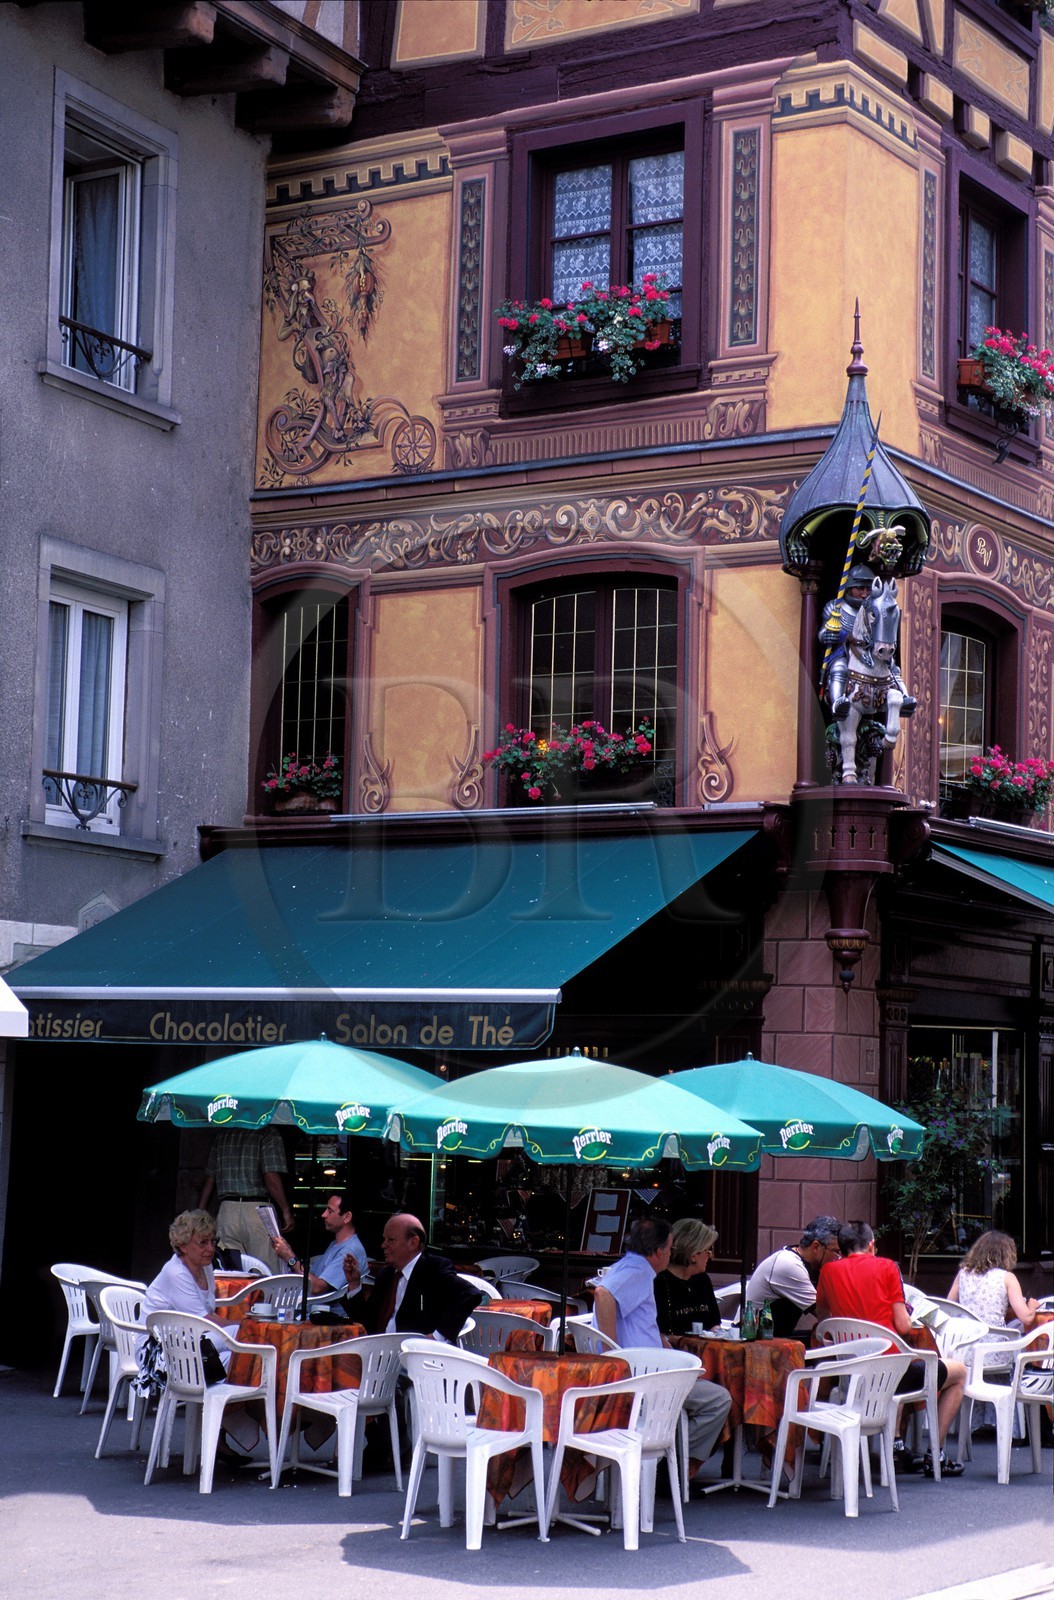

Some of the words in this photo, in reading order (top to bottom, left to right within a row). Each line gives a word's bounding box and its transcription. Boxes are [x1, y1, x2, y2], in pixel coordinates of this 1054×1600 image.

[150, 1012, 287, 1042] Chocolatier
[335, 1013, 407, 1044] Salon
[419, 1015, 454, 1045] de
[468, 1015, 515, 1046] Thé
